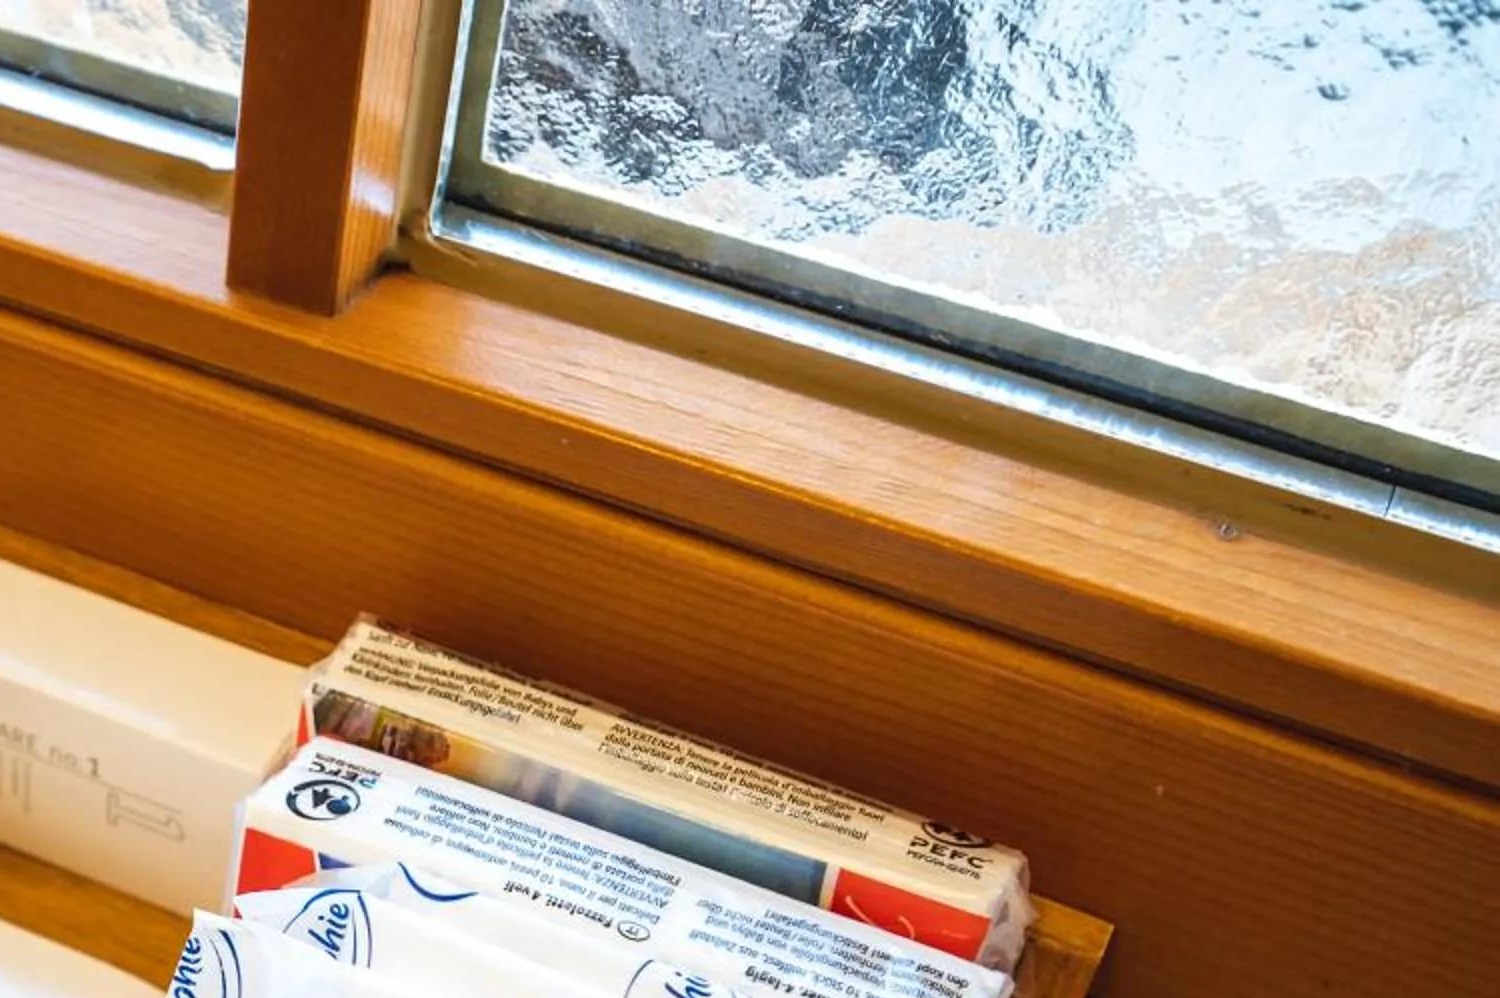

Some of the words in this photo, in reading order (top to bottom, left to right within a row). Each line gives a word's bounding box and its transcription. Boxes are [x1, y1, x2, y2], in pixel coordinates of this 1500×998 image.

[307, 762, 376, 788] PEFC
[909, 836, 994, 869] PEFC
[538, 871, 555, 886] 10
[603, 864, 646, 885] portata
[502, 880, 530, 899] veli
[530, 890, 541, 902] 4
[843, 984, 861, 998] 10
